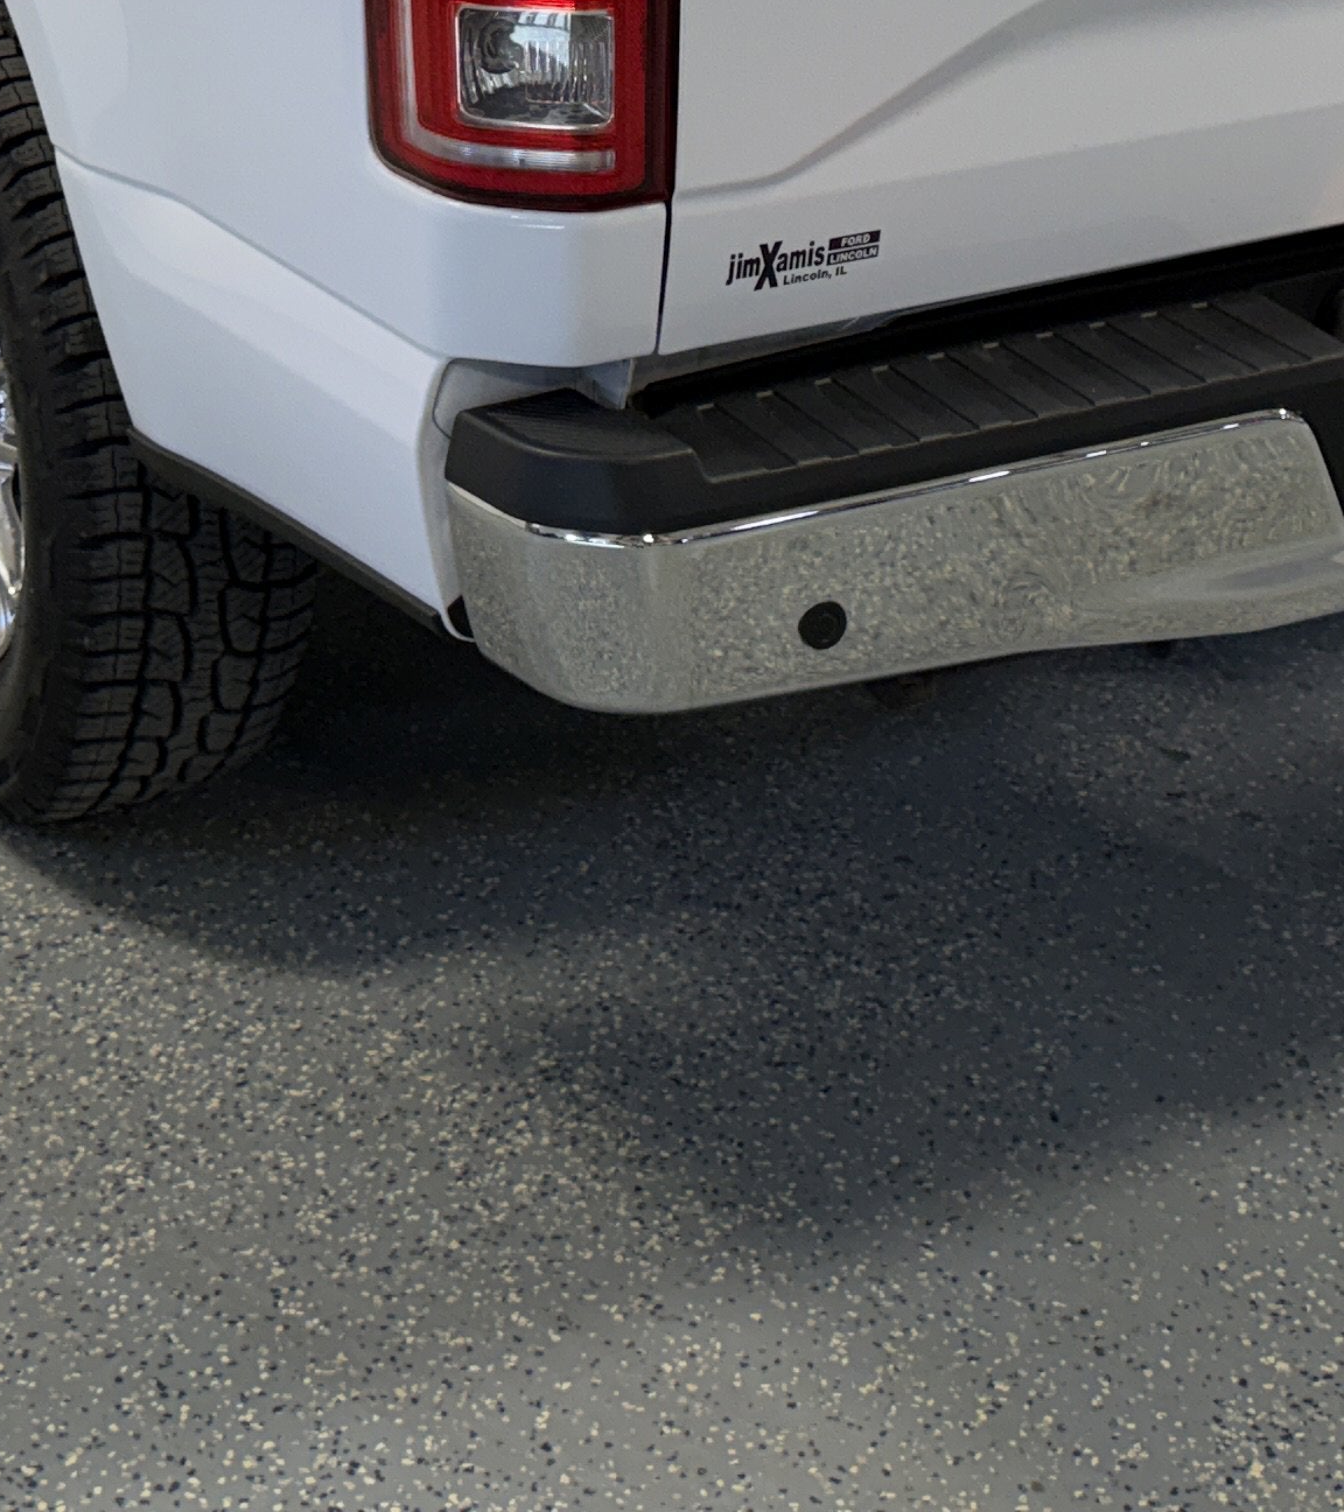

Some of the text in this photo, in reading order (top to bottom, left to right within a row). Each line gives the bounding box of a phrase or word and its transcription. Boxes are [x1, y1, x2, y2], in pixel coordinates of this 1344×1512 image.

[840, 233, 871, 247] FORD
[725, 240, 826, 292] jimXamis
[830, 249, 878, 265] LINCOLN
[783, 266, 848, 286] Lincoln, IL
